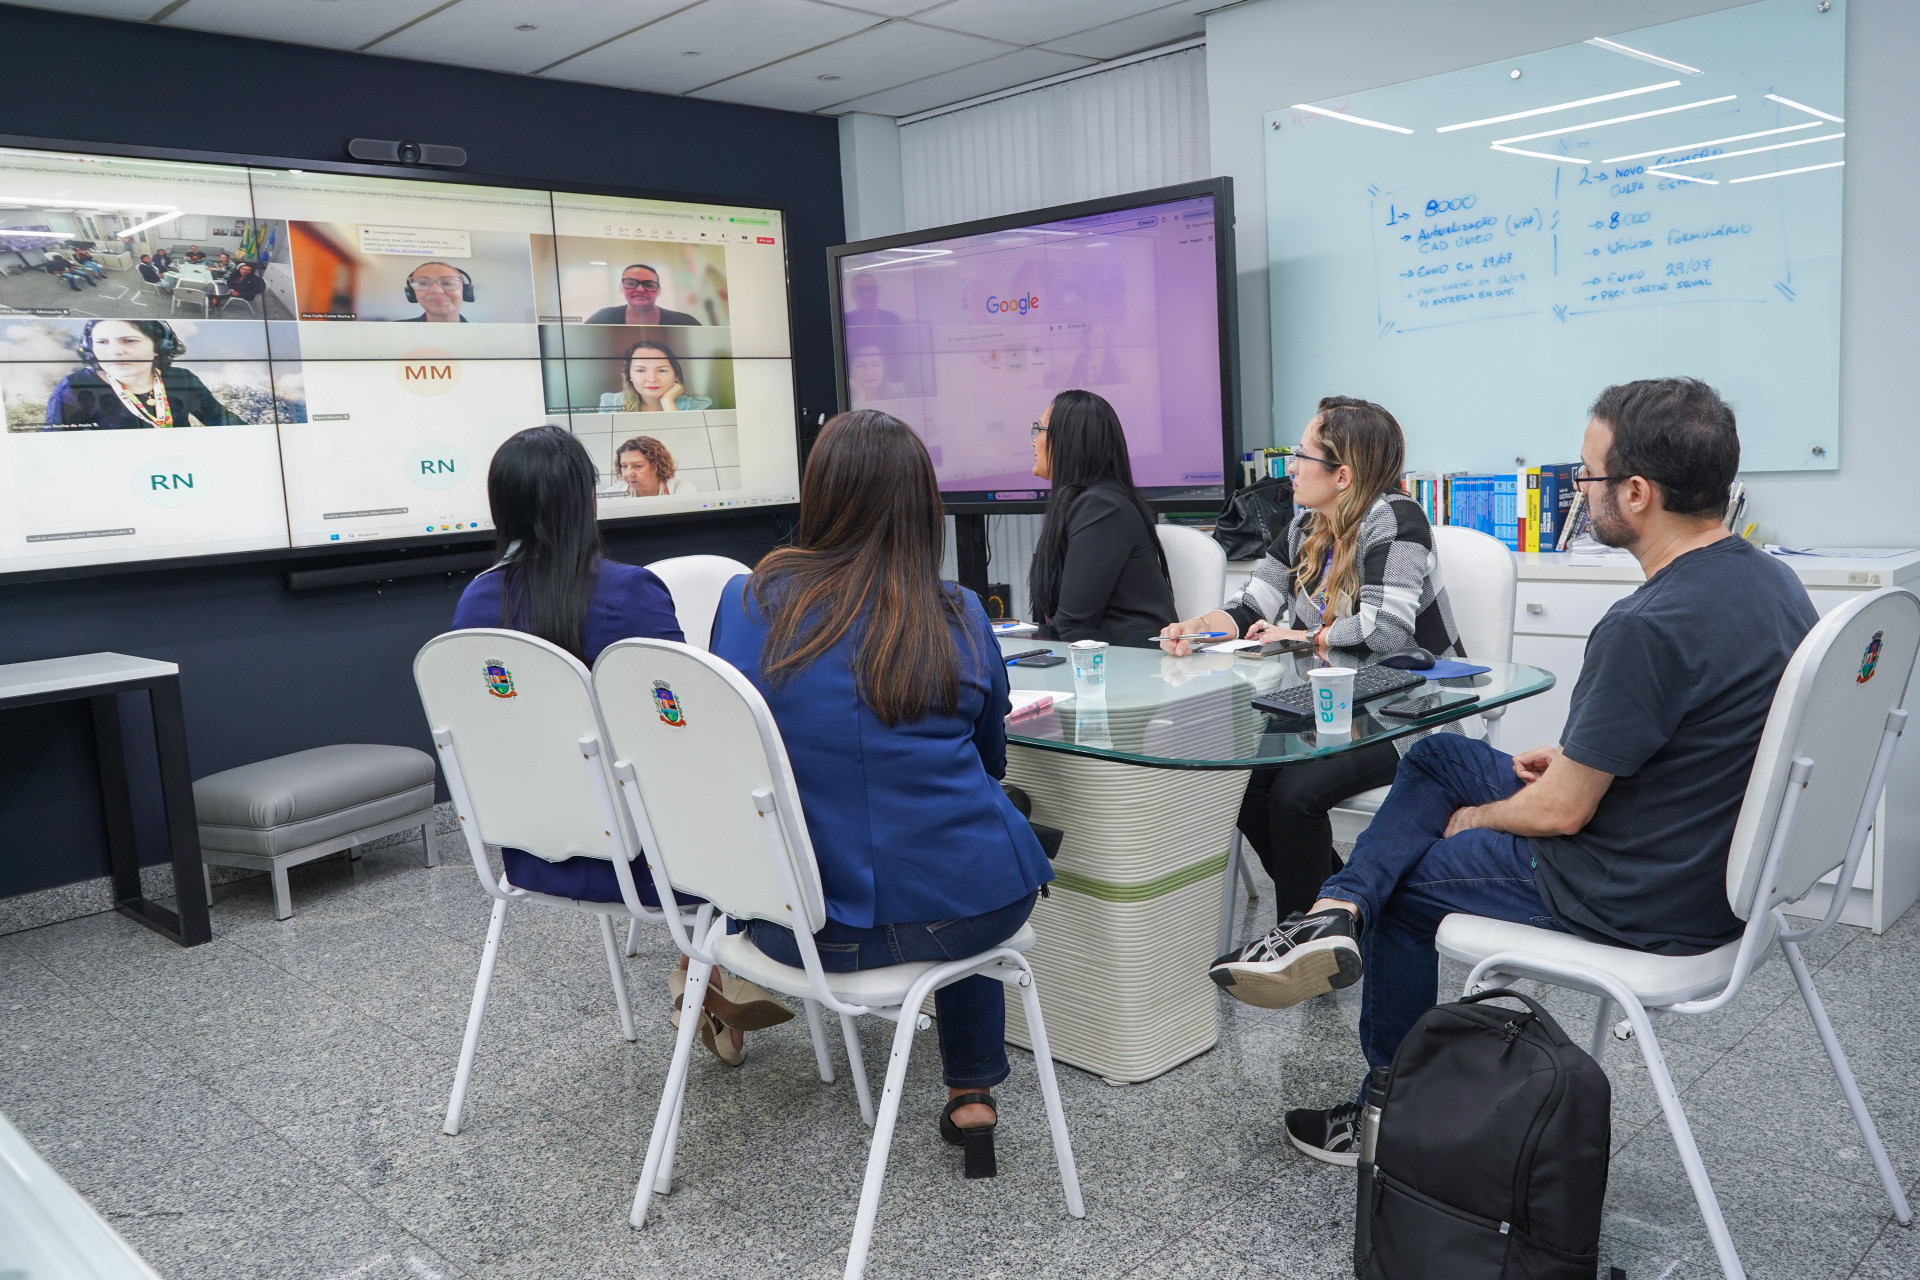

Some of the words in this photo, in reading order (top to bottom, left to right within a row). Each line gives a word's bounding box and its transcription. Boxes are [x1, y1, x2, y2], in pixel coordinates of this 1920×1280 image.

[1615, 165, 1644, 179] NOVO
[1666, 257, 1712, 276] 29/07
[986, 291, 1039, 316] Google
[404, 365, 453, 380] MM
[420, 458, 455, 475] RN
[150, 473, 194, 491] RN
[1559, 499, 1573, 508] PÚBLIC
[1319, 688, 1333, 723] eco
